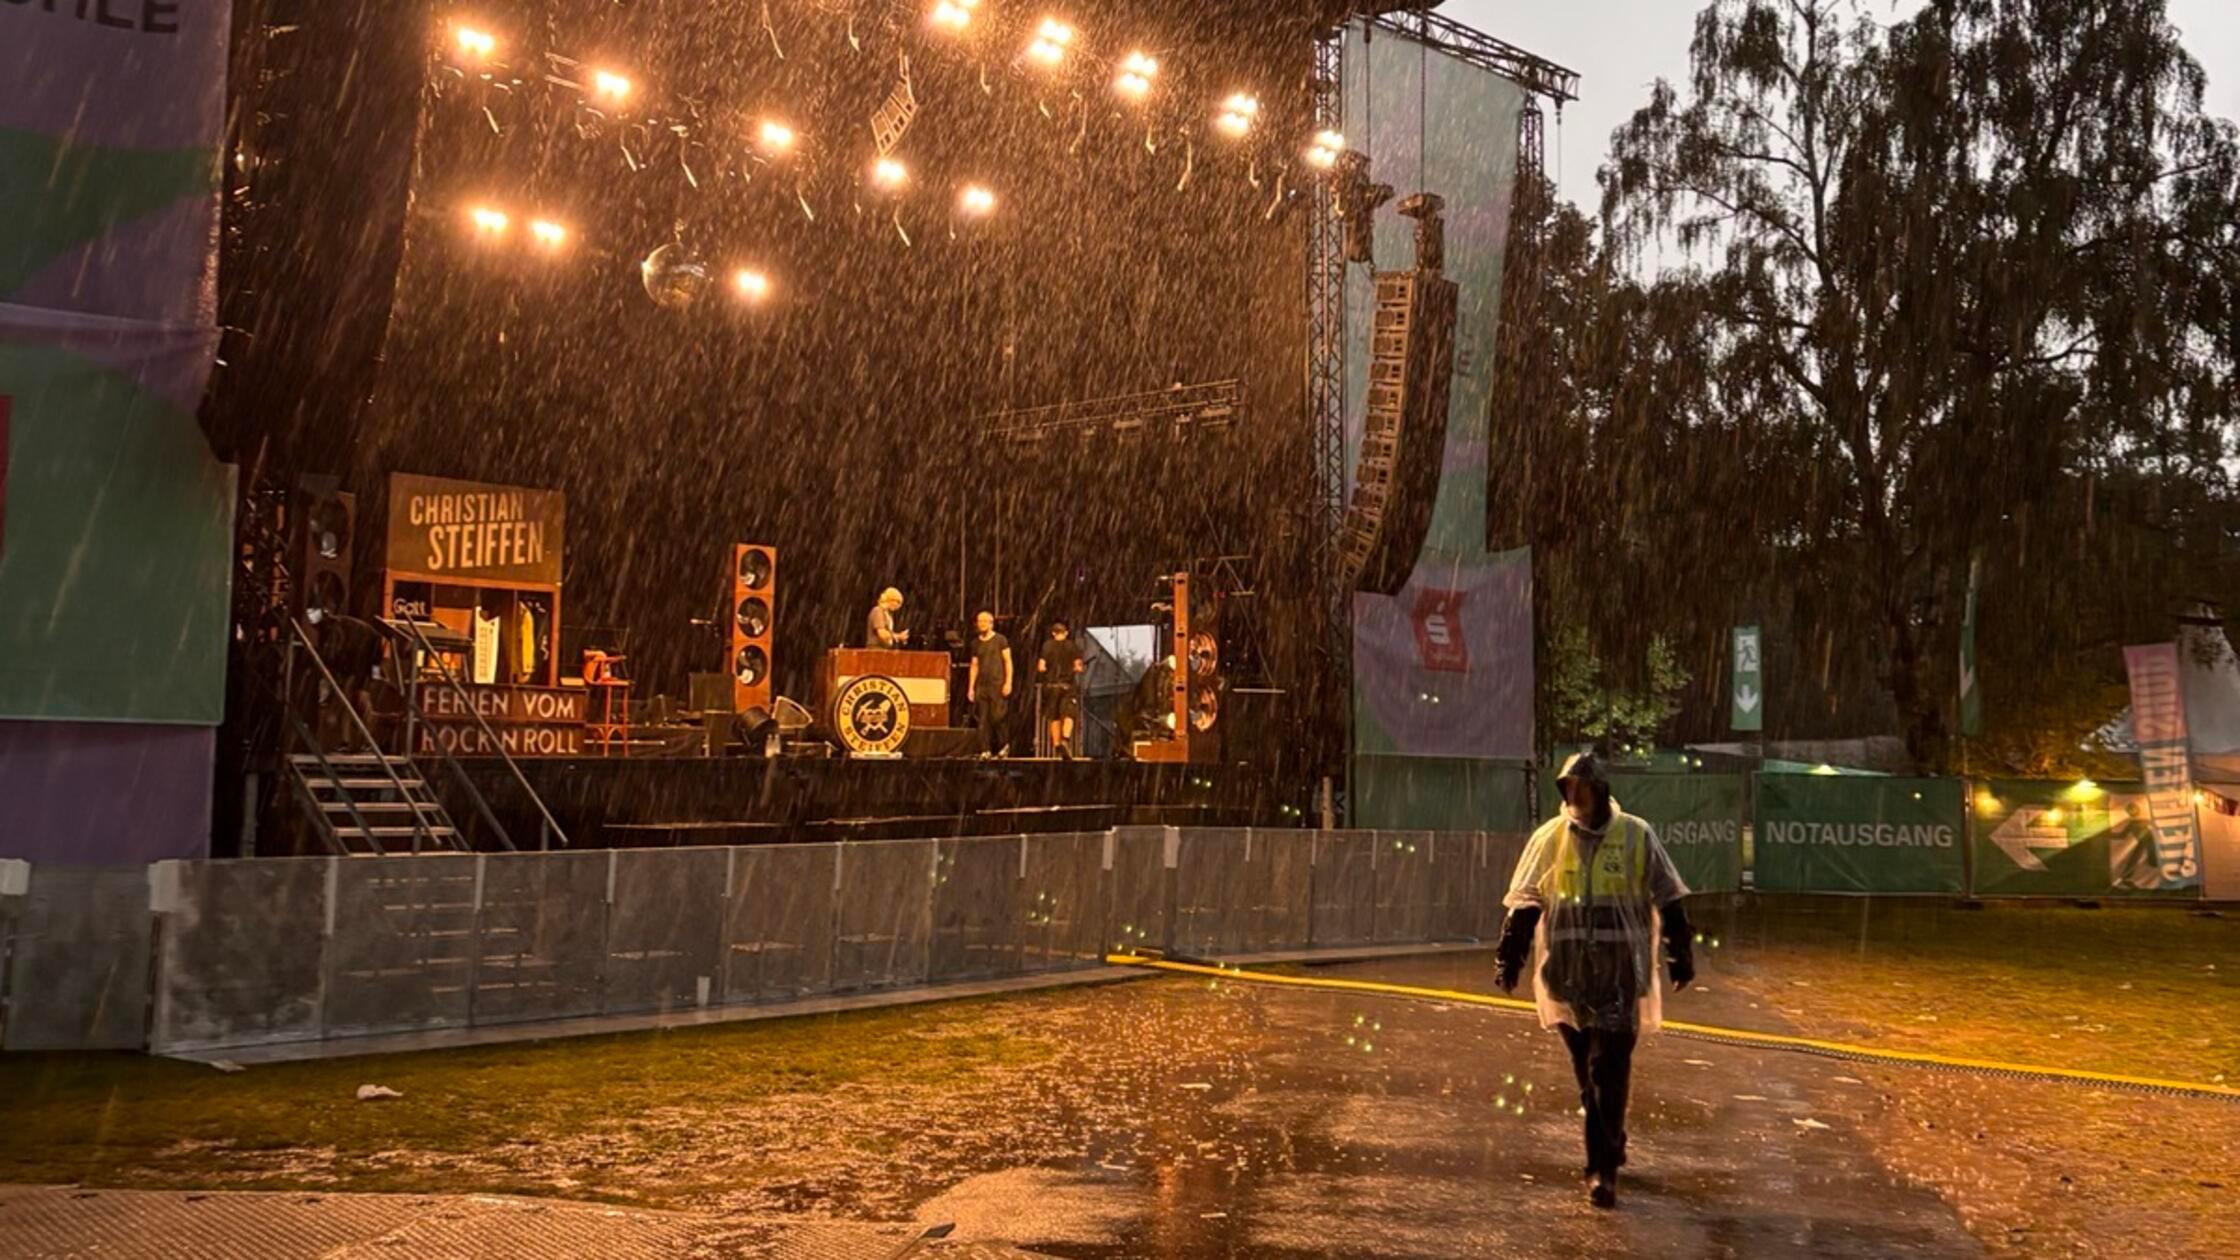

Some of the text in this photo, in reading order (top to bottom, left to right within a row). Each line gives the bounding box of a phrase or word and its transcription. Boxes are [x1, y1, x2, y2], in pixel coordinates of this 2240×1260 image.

[410, 491, 523, 525] CHRISTIAN
[427, 521, 544, 570] STEIFFEN
[523, 693, 575, 718] VOM
[841, 680, 907, 716] CHRISTIAN
[1650, 819, 1736, 845] USGANG
[1766, 821, 1953, 847] NOTAUSGANG
